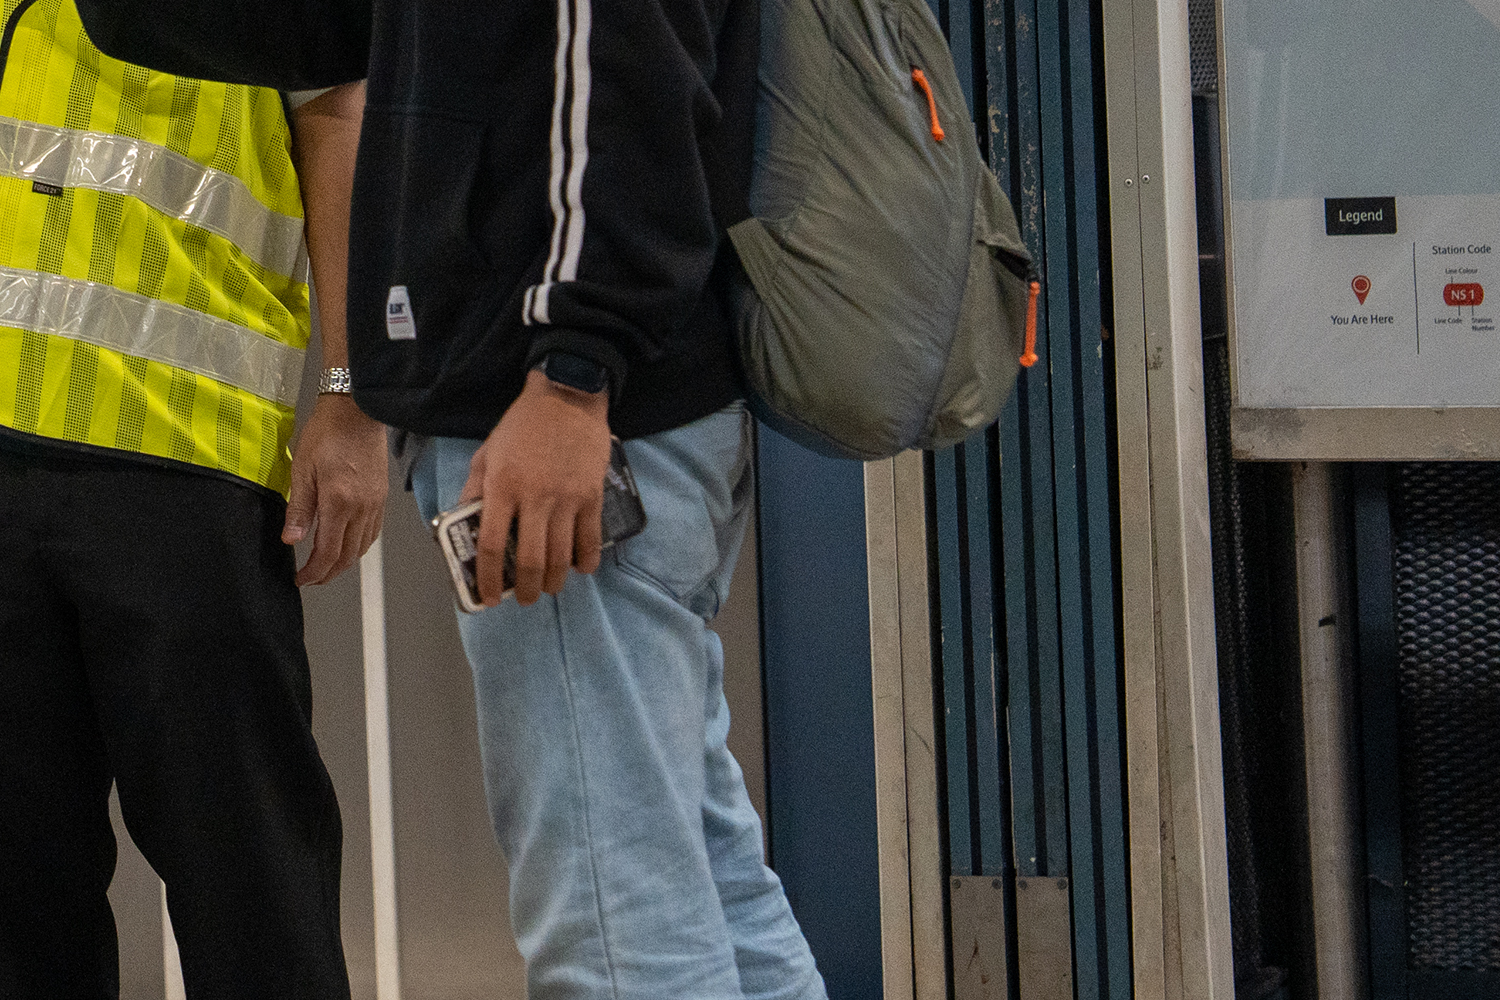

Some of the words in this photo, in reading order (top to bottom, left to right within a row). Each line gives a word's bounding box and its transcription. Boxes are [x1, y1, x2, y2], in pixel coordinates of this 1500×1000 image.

[1339, 208, 1383, 225] Legend
[1432, 245, 1465, 255] Station
[1467, 244, 1491, 254] Code
[1451, 289, 1467, 300] NS
[1469, 289, 1475, 300] 1
[1330, 314, 1349, 325] You
[1351, 314, 1368, 324] Are
[1370, 313, 1394, 324] Here
